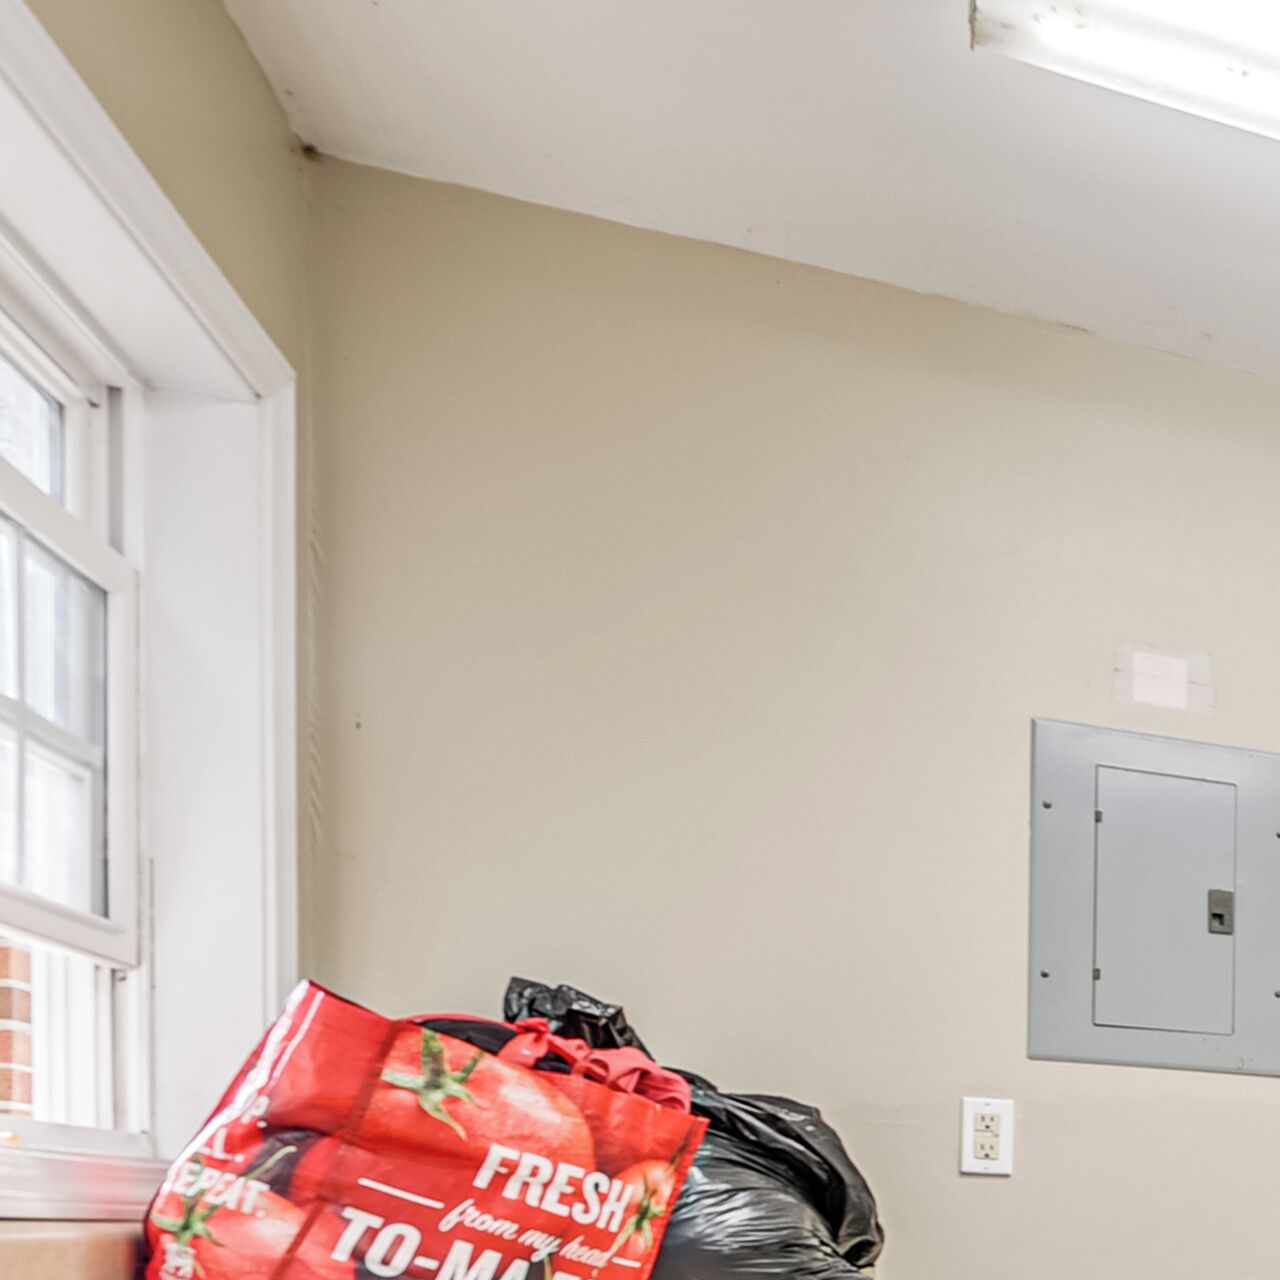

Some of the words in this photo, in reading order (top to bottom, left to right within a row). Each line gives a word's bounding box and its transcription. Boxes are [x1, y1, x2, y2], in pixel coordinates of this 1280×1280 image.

[472, 1142, 635, 1233] FRESH
[438, 1198, 520, 1240] from
[517, 1229, 563, 1263] my
[558, 1235, 613, 1268] head
